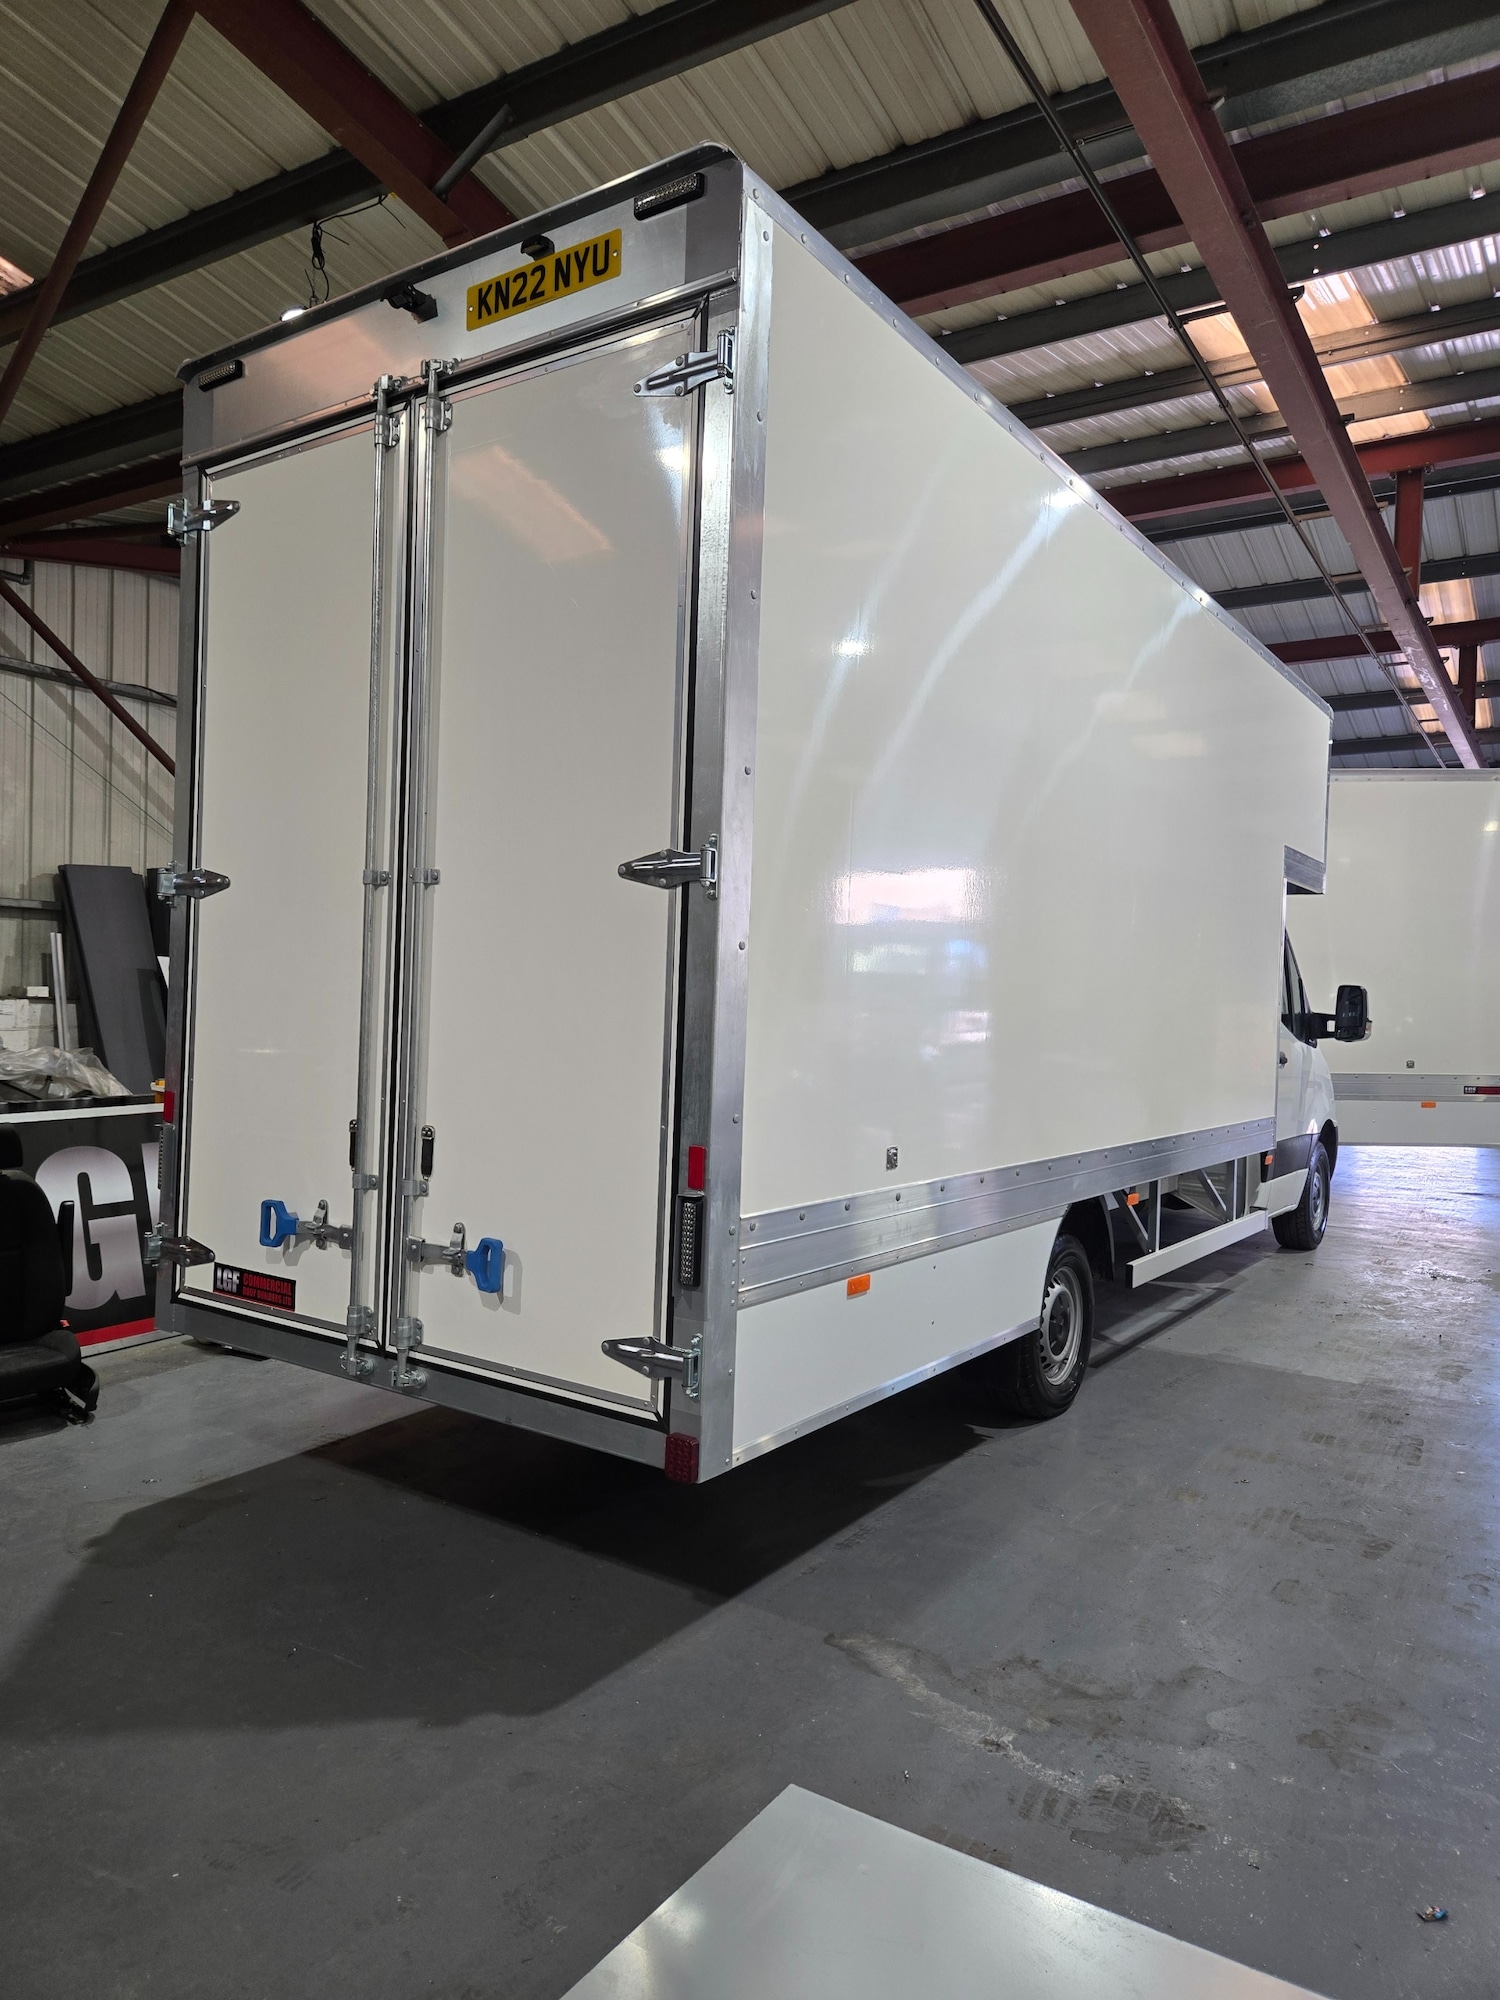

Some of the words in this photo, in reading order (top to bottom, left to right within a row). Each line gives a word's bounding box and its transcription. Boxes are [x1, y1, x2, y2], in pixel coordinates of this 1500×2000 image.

[477, 264, 546, 320] KN22
[554, 239, 610, 292] NYU
[216, 1266, 240, 1293] LGF
[243, 1272, 292, 1296] COMMERCIAL
